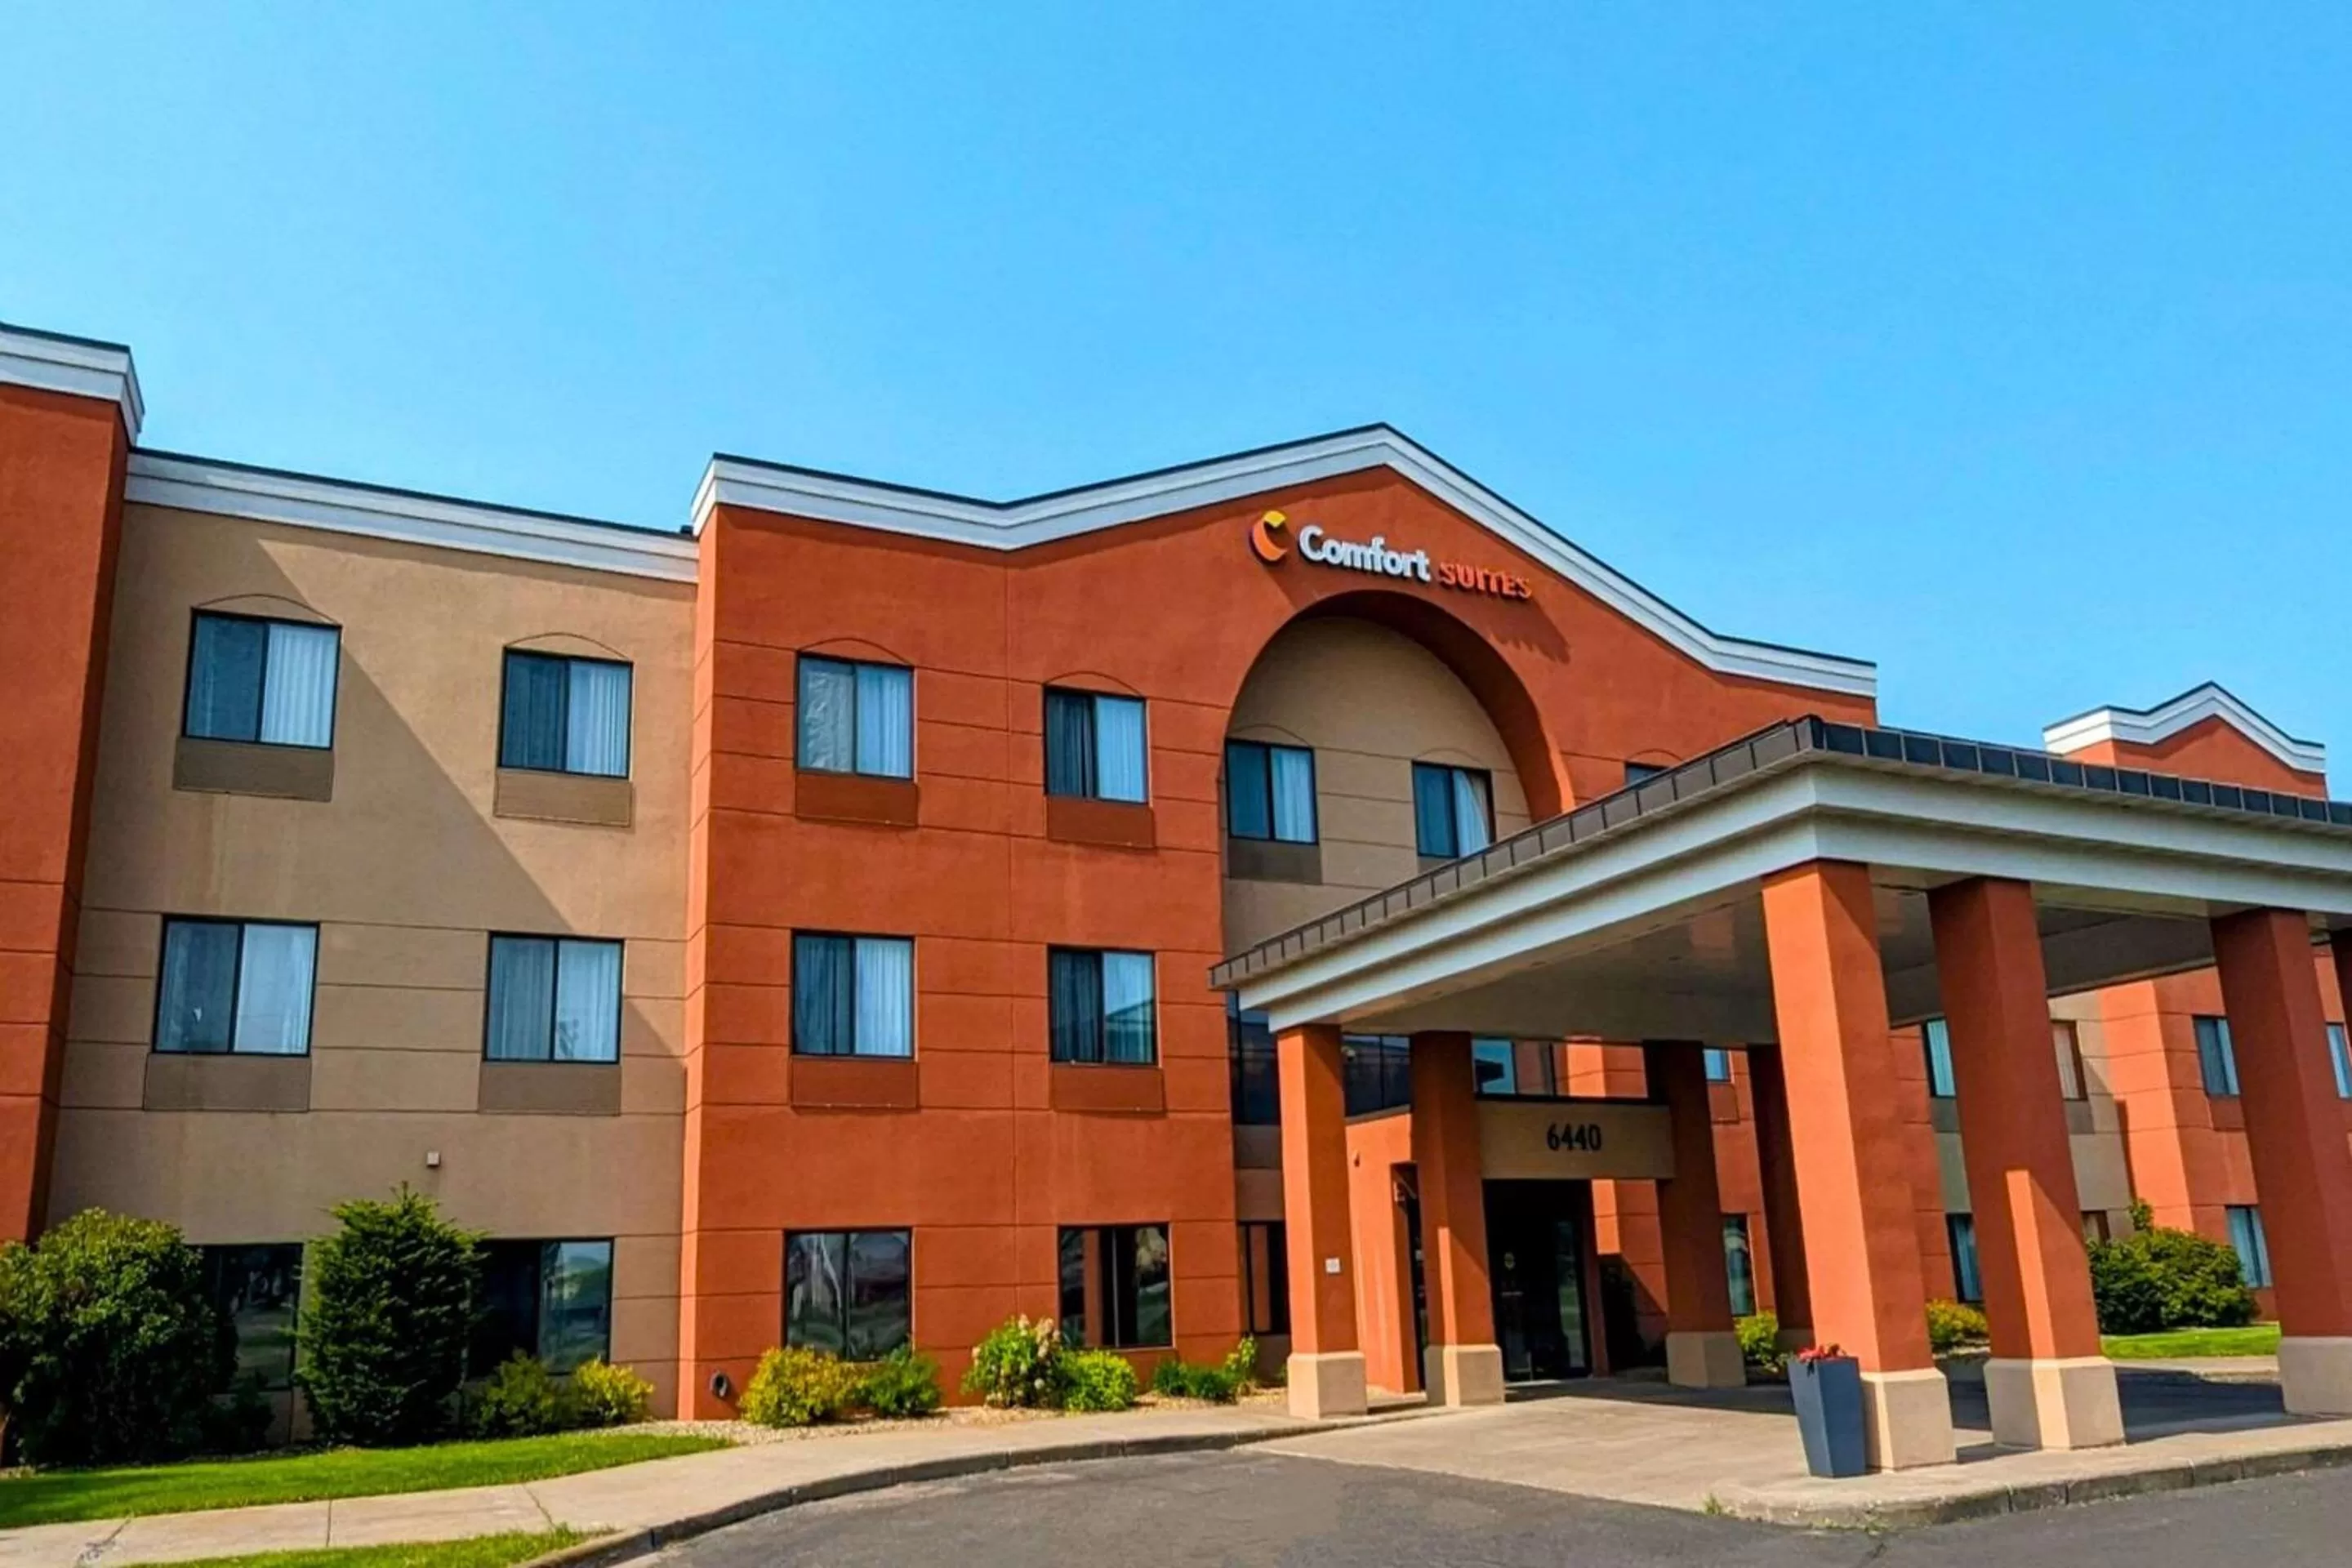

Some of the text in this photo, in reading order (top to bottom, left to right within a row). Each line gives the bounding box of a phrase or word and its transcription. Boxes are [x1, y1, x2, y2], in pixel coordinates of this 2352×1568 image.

[1298, 524, 1532, 599] Comfort SUITES
[1547, 1123, 1602, 1152] 6440
